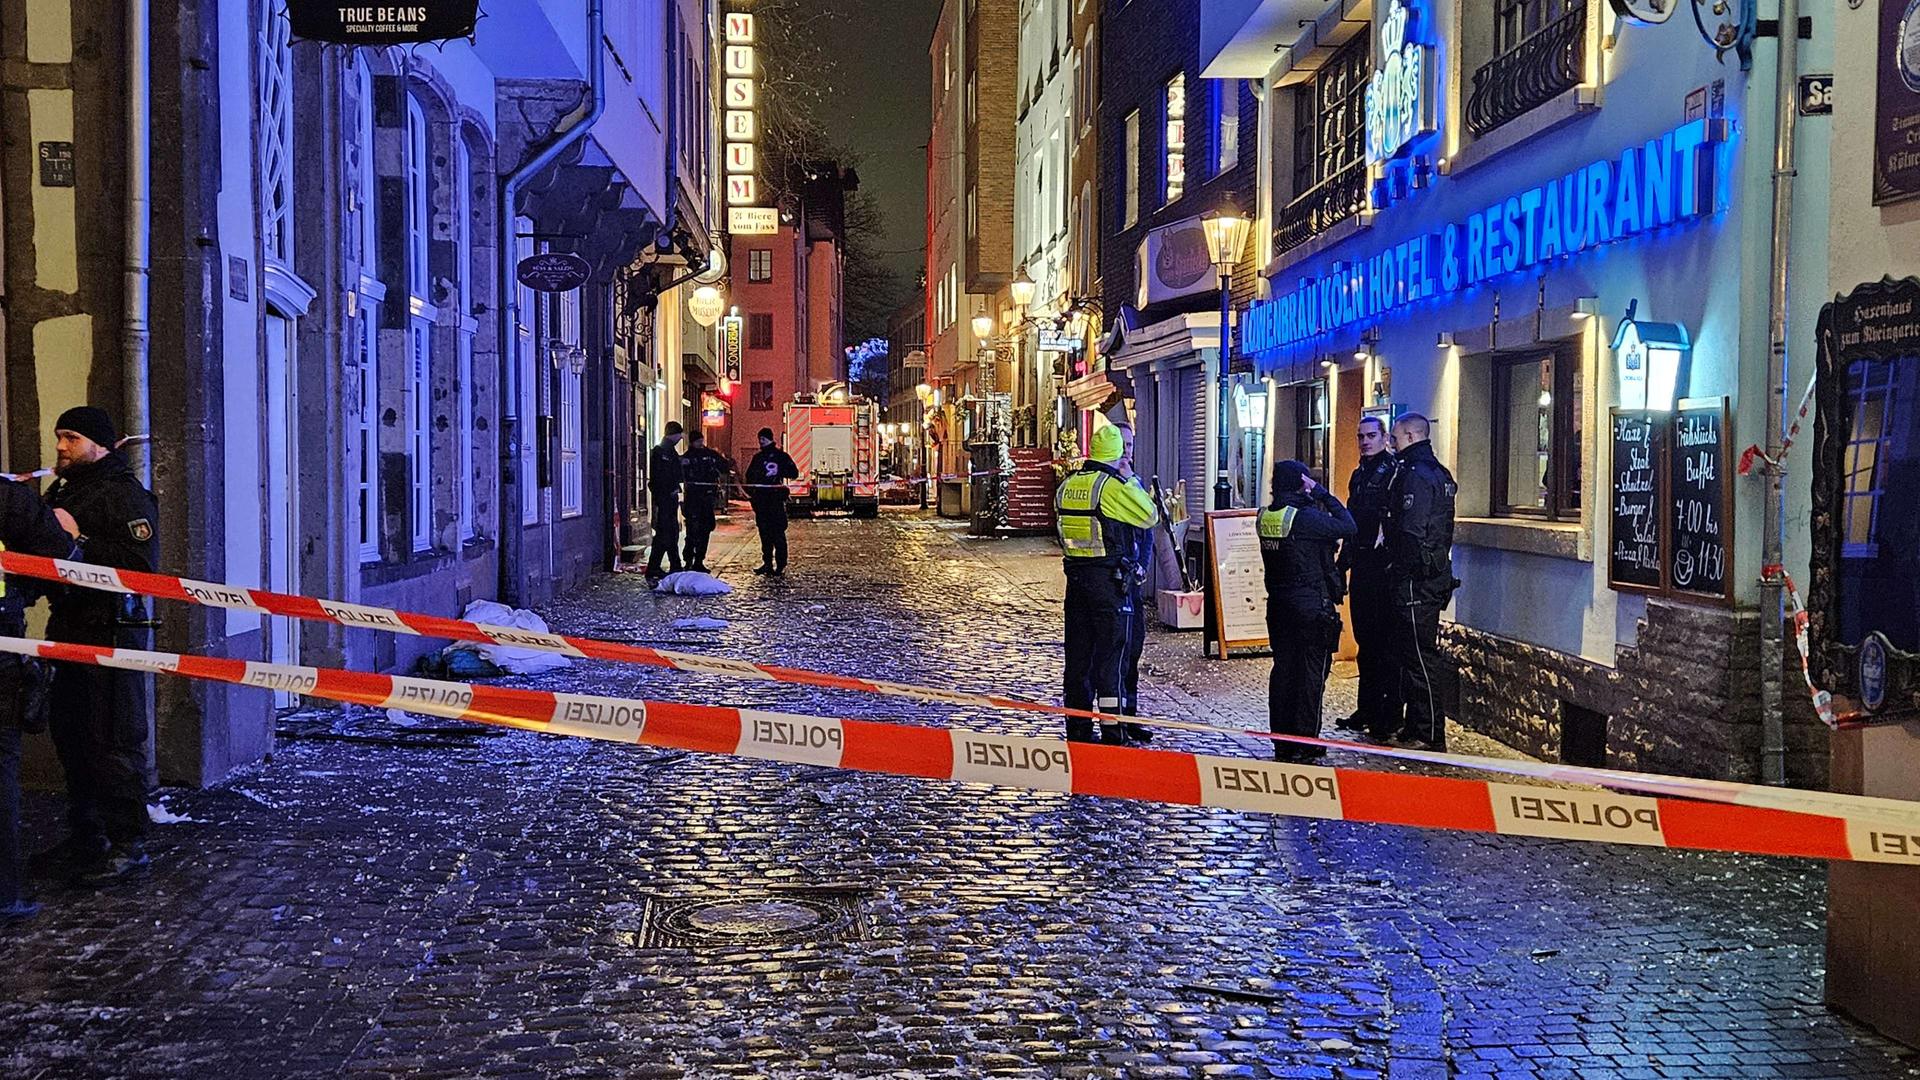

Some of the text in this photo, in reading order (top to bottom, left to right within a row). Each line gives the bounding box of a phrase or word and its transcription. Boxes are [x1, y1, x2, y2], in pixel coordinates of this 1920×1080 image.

[338, 7, 427, 22] TRUE BEANS
[346, 25, 374, 33] SPECIALTY
[402, 24, 418, 32] MORE
[1809, 80, 1833, 106] Sa
[729, 18, 750, 198] MUSEUM
[1241, 118, 1704, 355] LÖWENBRÄU KÖLN HOTEL & RESTAURANT
[727, 322, 739, 367] SONDERBAR
[1686, 451, 1715, 490] Buffet
[1064, 488, 1089, 500] POLIZEI
[1619, 495, 1646, 528] Burger
[1705, 503, 1719, 535] bis
[1632, 522, 1657, 544] Salat
[324, 607, 395, 627] POLIZEI
[483, 630, 567, 650] POLIZEI
